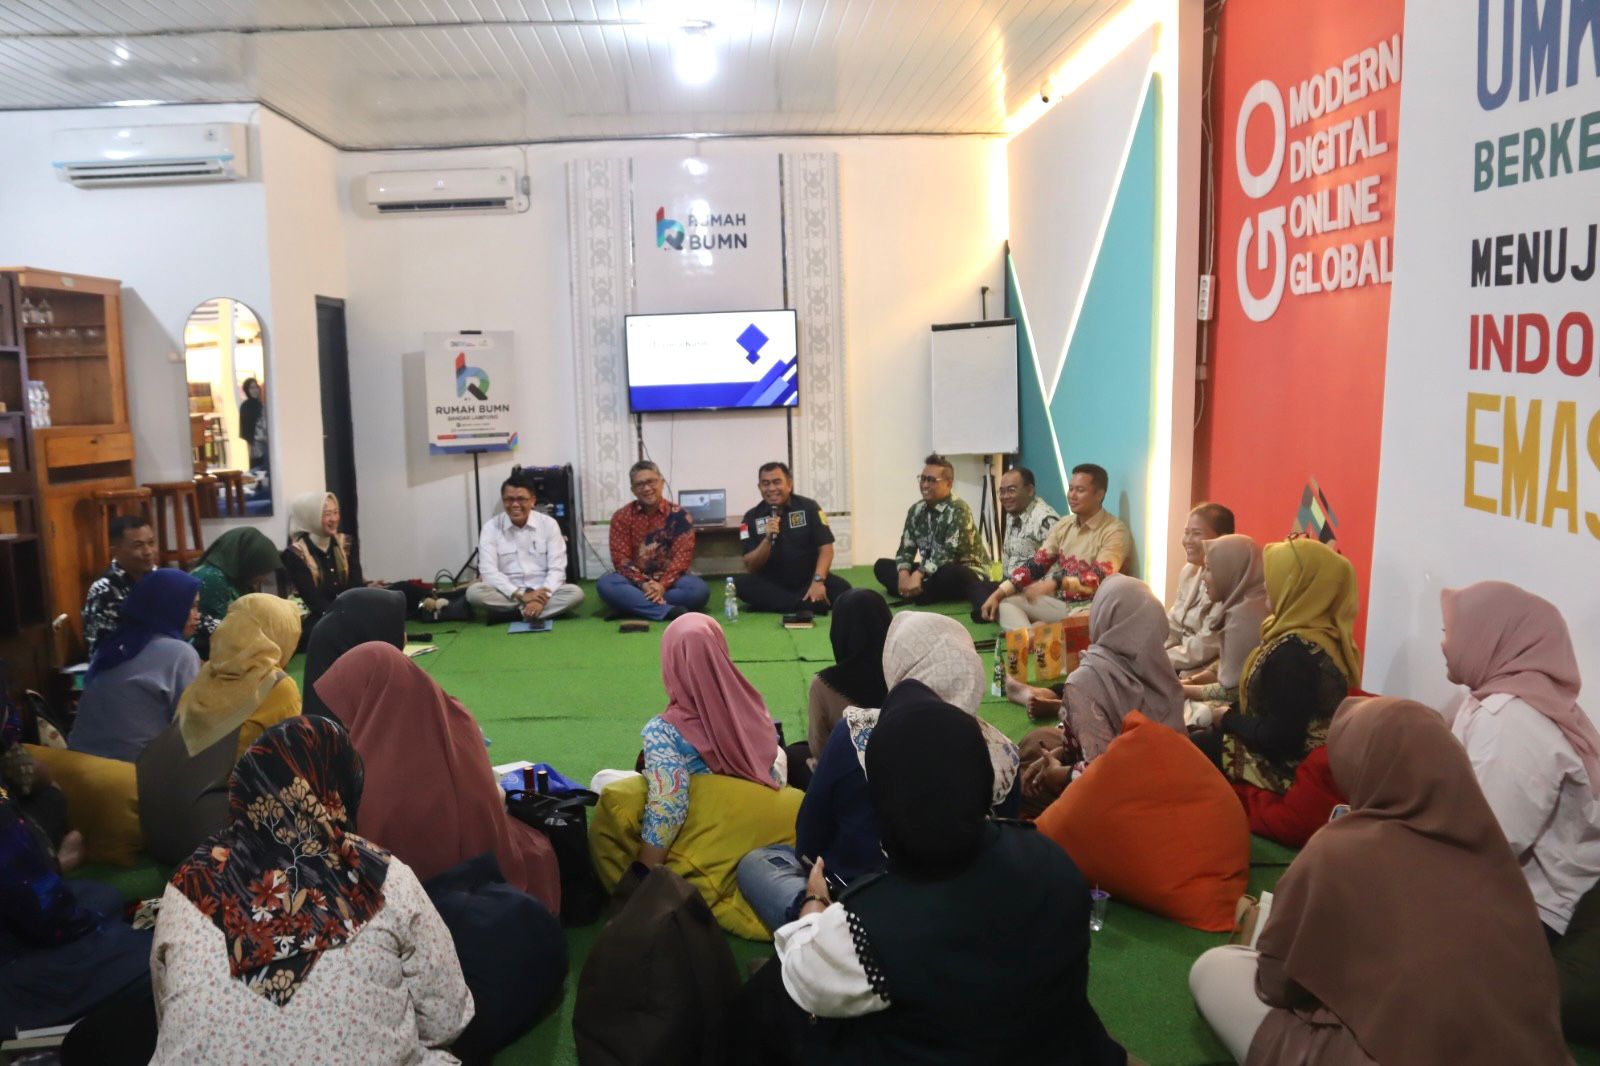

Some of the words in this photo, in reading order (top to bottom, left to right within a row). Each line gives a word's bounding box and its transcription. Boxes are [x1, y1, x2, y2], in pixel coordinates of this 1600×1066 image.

[1289, 33, 1400, 128] MODERN
[1289, 110, 1388, 183] DIGITAL
[1474, 111, 1600, 192] BERKE
[1289, 175, 1380, 238] ONLINE
[689, 233, 748, 250] BUMN
[1289, 236, 1393, 295] GLOBAL
[1471, 224, 1598, 287] MENUJ
[1470, 311, 1600, 377] INDO
[436, 406, 475, 415] RUMAH
[479, 404, 510, 413] BUMN
